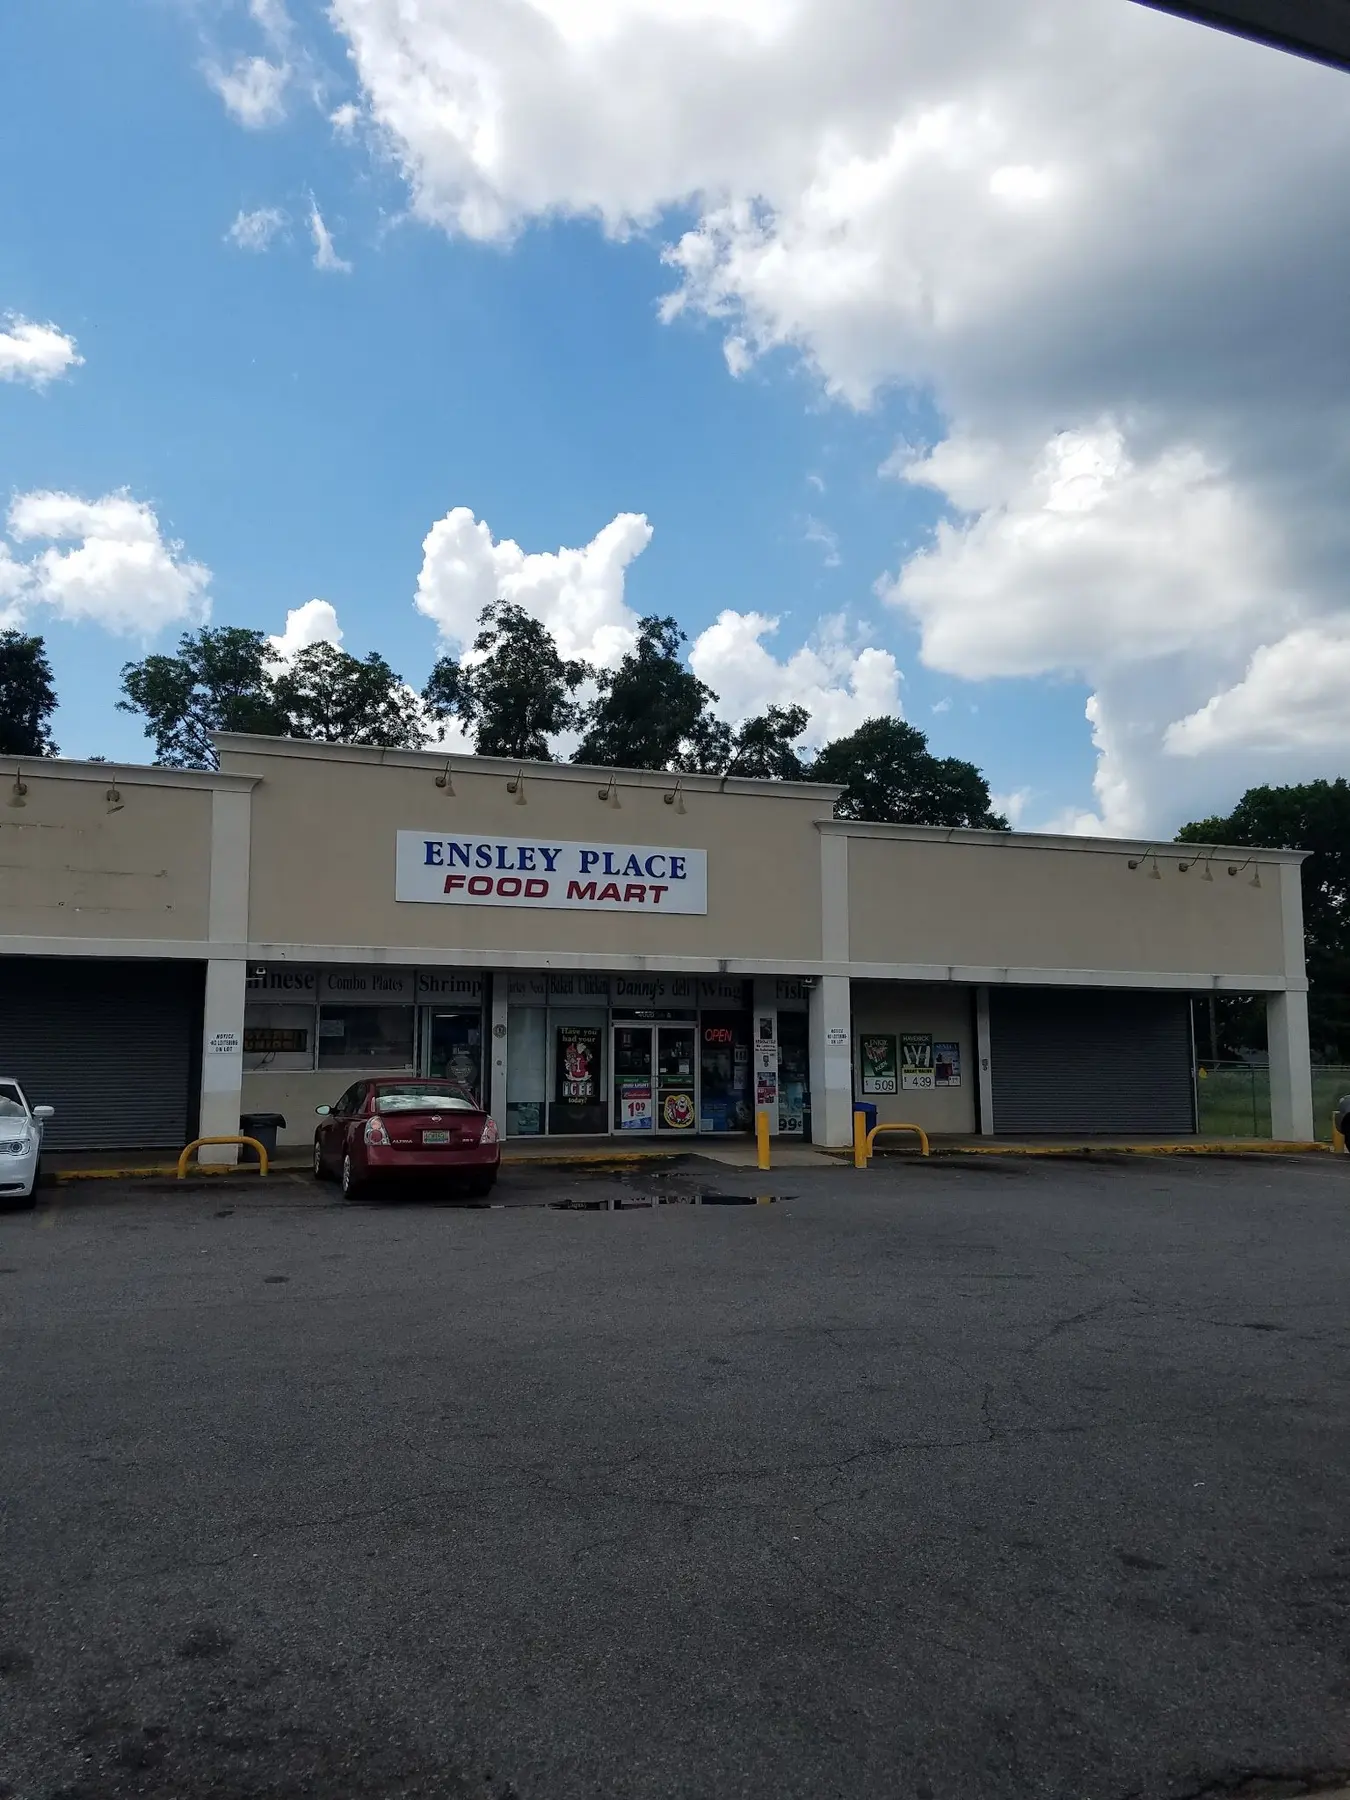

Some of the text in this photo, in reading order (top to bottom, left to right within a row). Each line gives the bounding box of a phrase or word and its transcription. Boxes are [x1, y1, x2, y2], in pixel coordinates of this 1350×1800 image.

[423, 841, 687, 879] ENSLEY PLACE
[443, 875, 669, 904] FOOD MART
[328, 974, 403, 991] Combo Plates
[419, 974, 481, 997] Shrimp
[616, 977, 665, 1000] Danny's
[704, 1028, 732, 1043] OPEN
[562, 1081, 594, 1097] ICEE
[568, 1097, 588, 1105] today?
